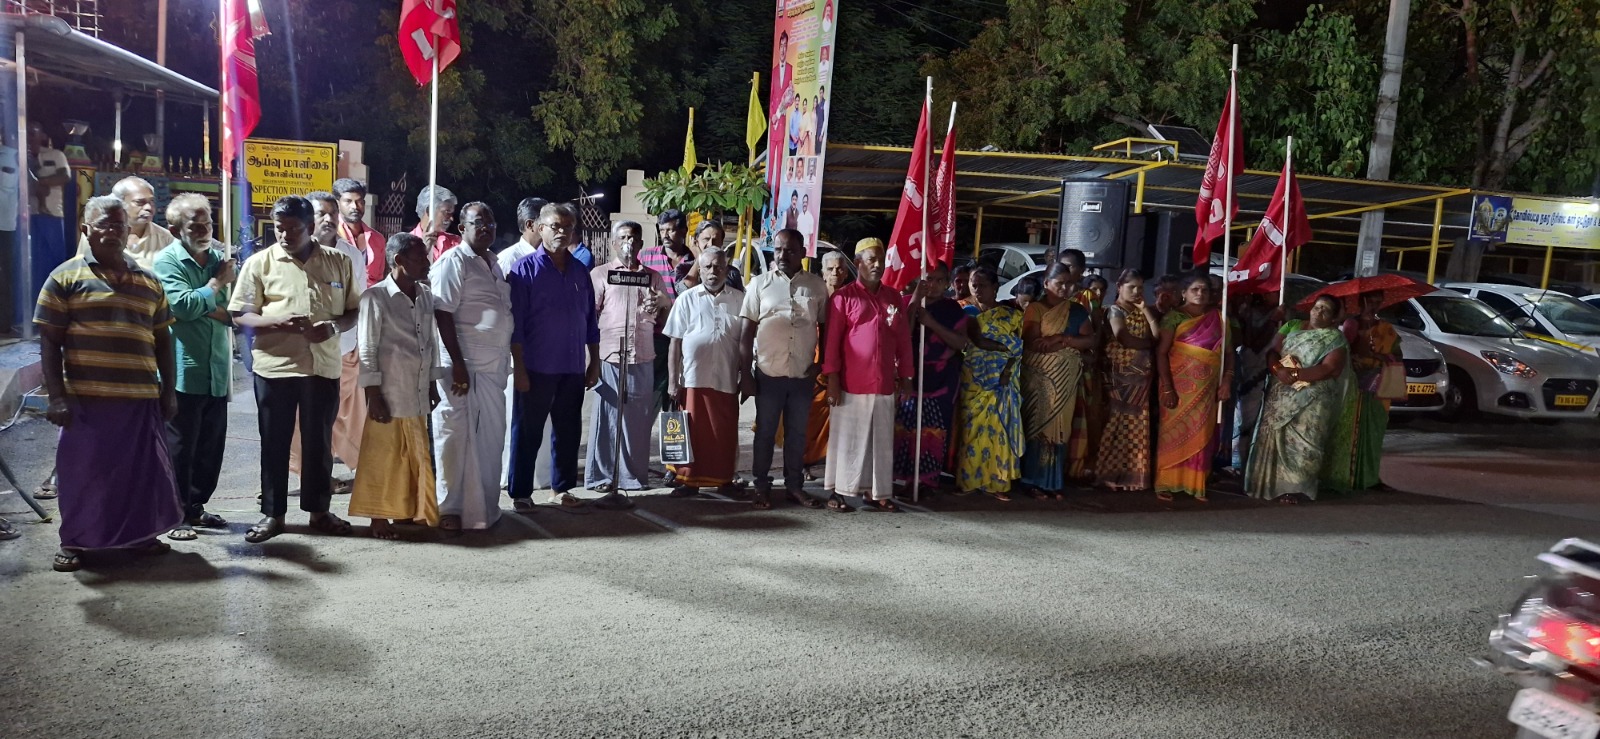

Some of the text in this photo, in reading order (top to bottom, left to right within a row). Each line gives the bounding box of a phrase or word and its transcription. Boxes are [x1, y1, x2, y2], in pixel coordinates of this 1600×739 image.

[247, 154, 329, 170] ஆய்வு மாளிகை
[264, 169, 313, 180] கோவில்பட்டி
[250, 185, 288, 194] NSPECTION
